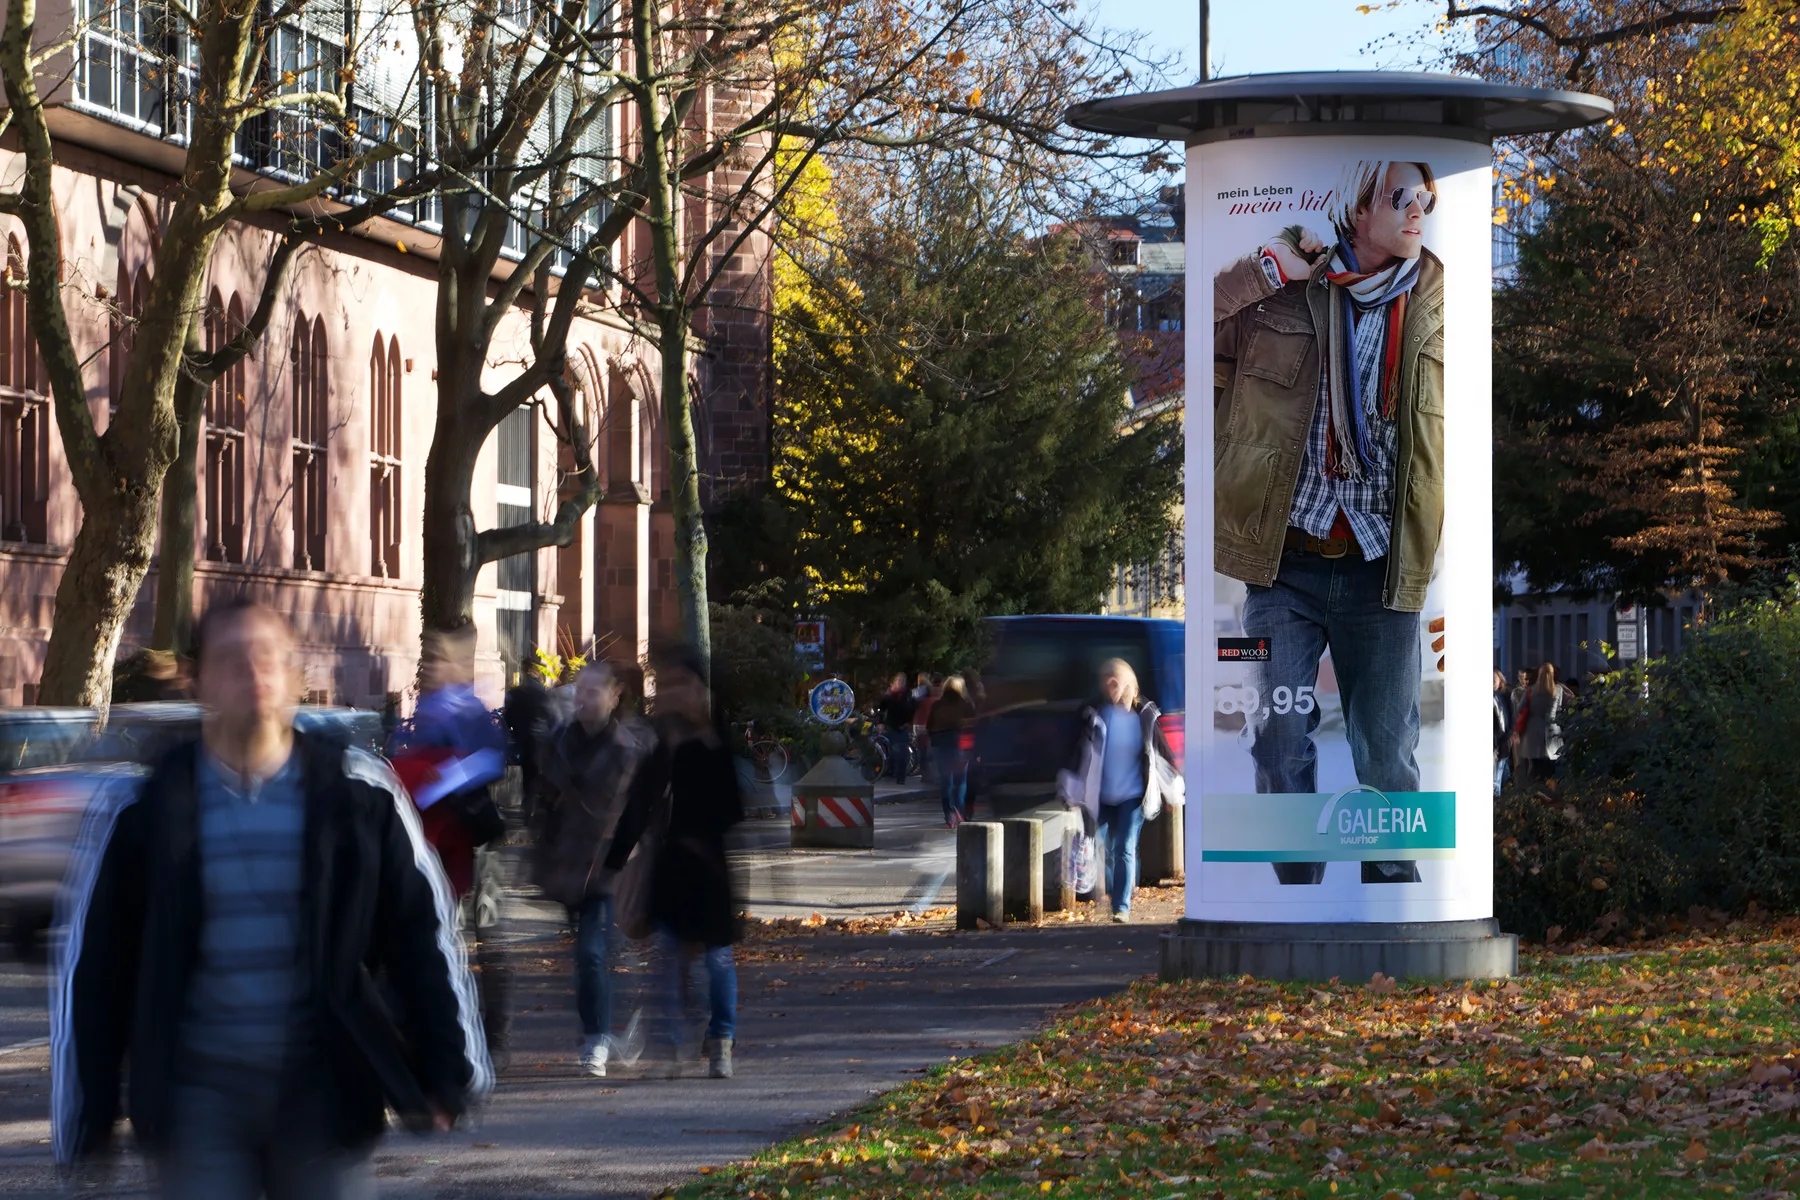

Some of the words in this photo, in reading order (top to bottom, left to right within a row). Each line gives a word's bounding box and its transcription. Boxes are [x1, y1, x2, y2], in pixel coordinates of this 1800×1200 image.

[1217, 188, 1249, 199] mein
[1254, 185, 1293, 197] Leben
[1228, 197, 1283, 215] mein
[1288, 189, 1333, 211] Stil
[1217, 685, 1315, 720] 89,95
[1337, 807, 1427, 834] GALERIA
